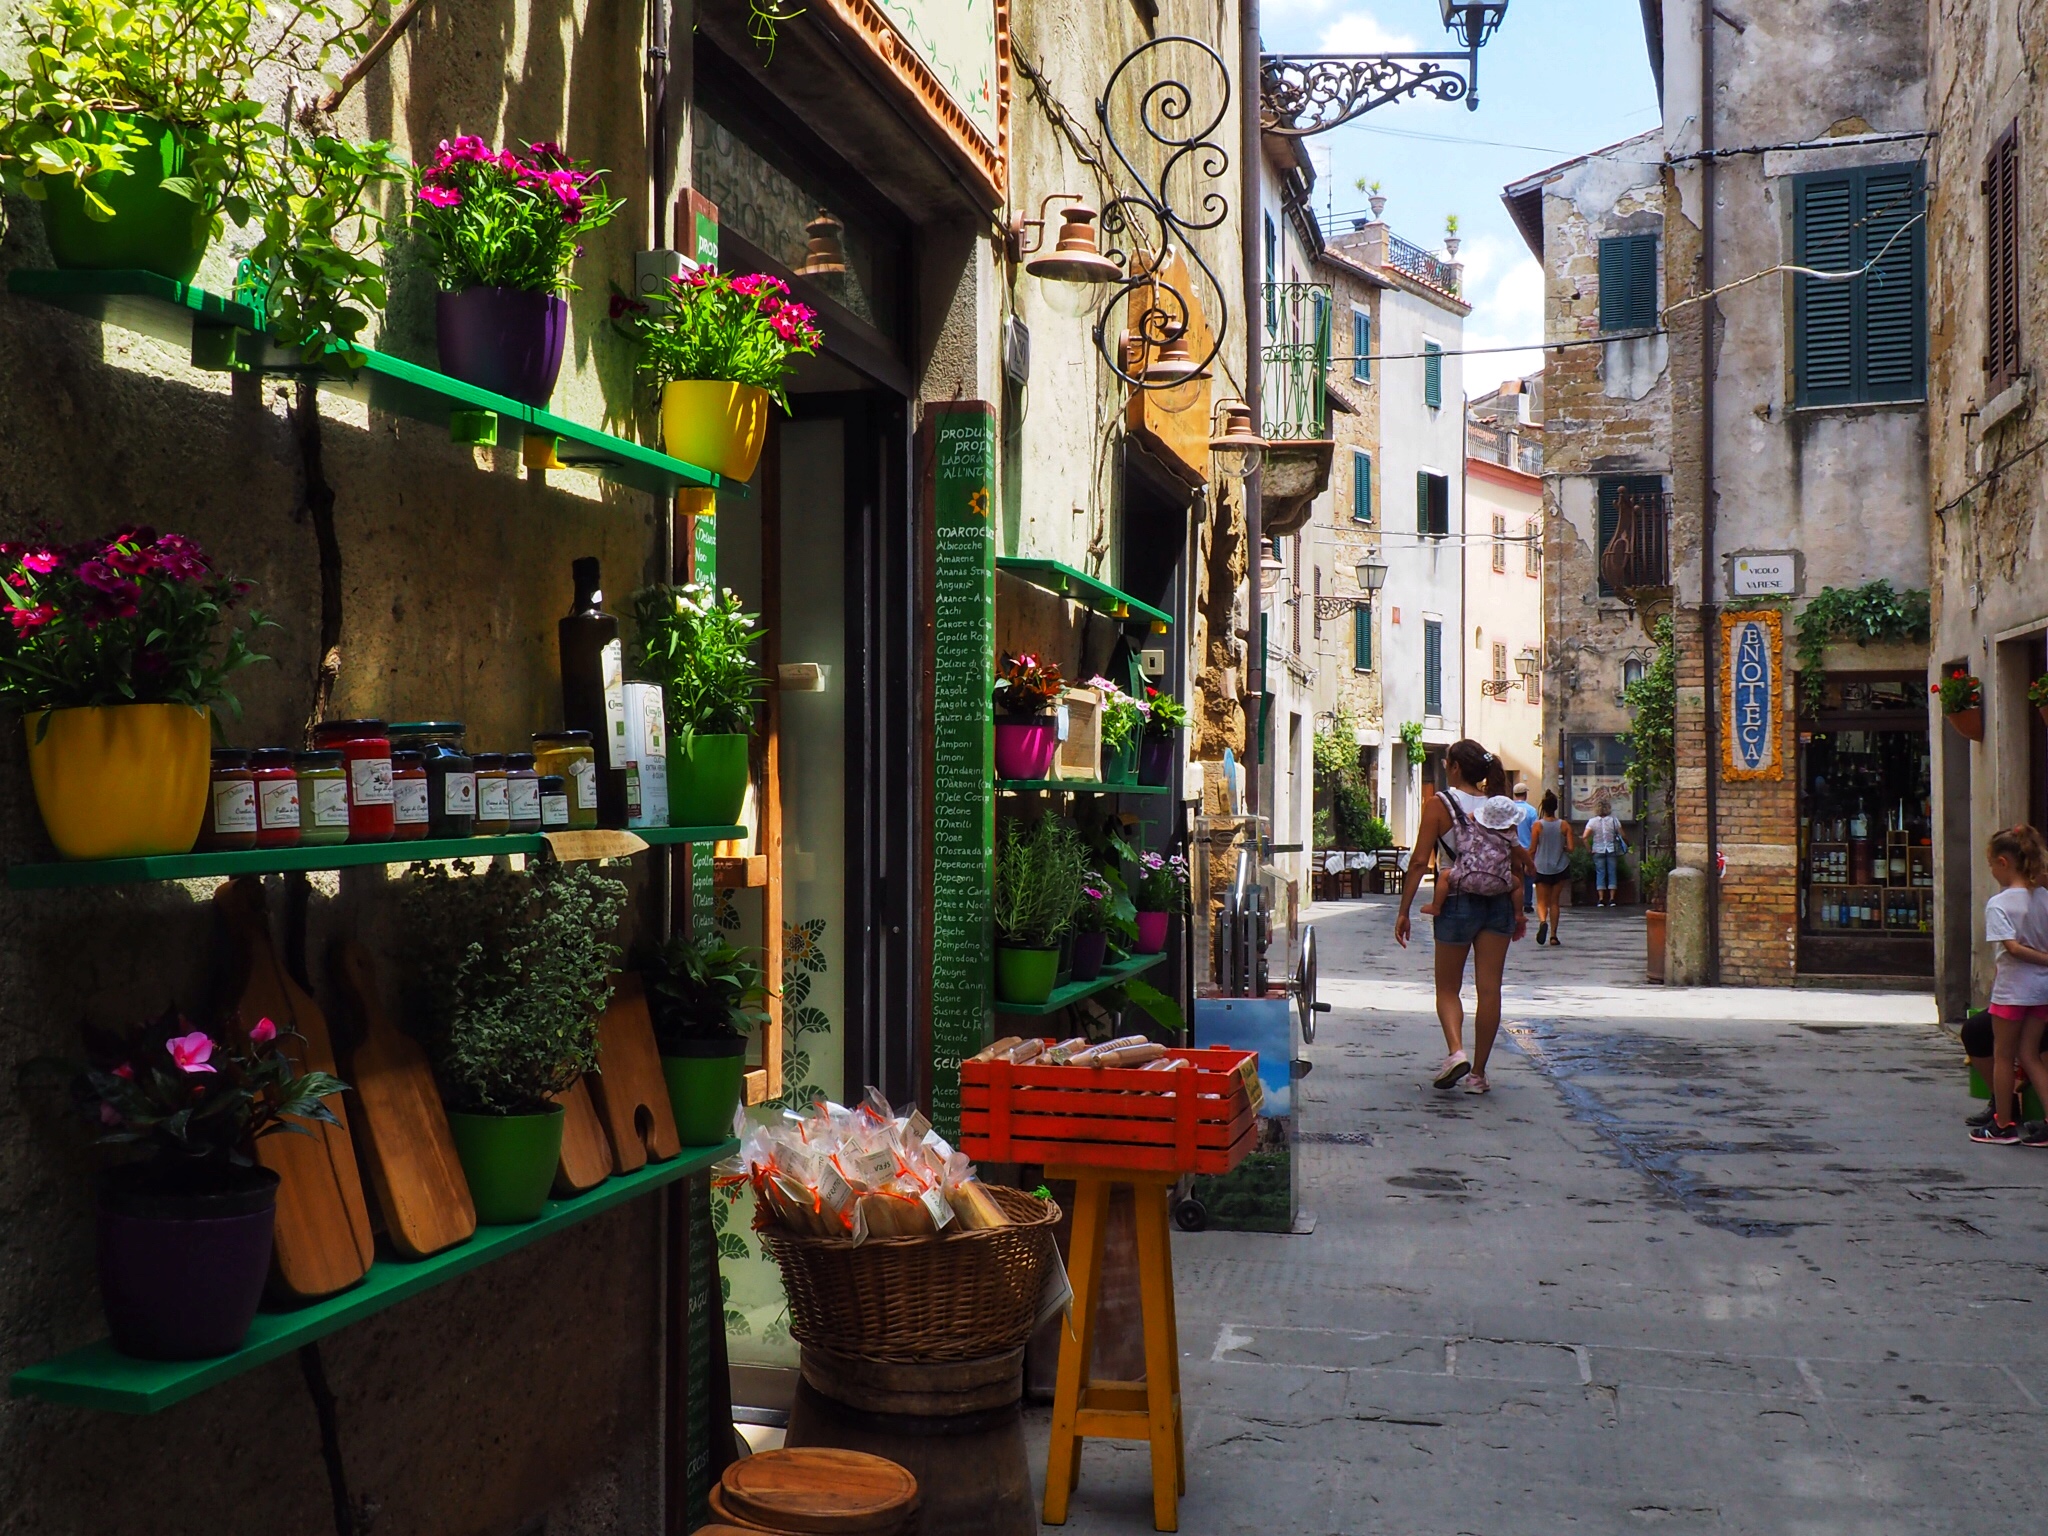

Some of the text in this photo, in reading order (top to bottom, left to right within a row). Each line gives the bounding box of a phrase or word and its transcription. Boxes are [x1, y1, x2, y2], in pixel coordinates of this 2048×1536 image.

[935, 540, 983, 551] Albicocche
[935, 553, 975, 564] Amarene
[935, 566, 968, 577] Ananas
[1748, 567, 1780, 575] VICOLO
[1746, 580, 1784, 589] VARESE
[936, 605, 962, 616] Cachi
[936, 618, 968, 629] Carote
[936, 632, 968, 643] Cipolle
[936, 645, 969, 657] Ciliegie
[935, 657, 967, 669] Delizie
[934, 671, 956, 684] Fichi
[934, 684, 968, 697] Fragole
[1738, 629, 1766, 761] ENOTECA
[934, 698, 968, 711] Fragole
[934, 712, 963, 725] Frutti
[935, 736, 973, 750] Lamponi
[935, 751, 965, 762] Limoni
[935, 792, 962, 802] Mele
[935, 805, 972, 816] Melone
[935, 818, 972, 829] Mirtilli
[935, 831, 963, 842] More
[935, 845, 982, 856] Mostarda
[933, 885, 957, 897] Pere
[933, 899, 957, 911] Pere
[933, 911, 957, 924] Pere
[933, 925, 966, 938] Pesche
[933, 939, 981, 952] Pompelmo
[932, 952, 978, 966] Pomodori
[932, 965, 967, 979] Prugne
[933, 979, 955, 990] Rosa
[933, 993, 962, 1003] Susine
[933, 1006, 961, 1016] Susine
[933, 1017, 951, 1028] Uva
[933, 1030, 968, 1042] Visciole
[933, 1044, 961, 1056] Zucca
